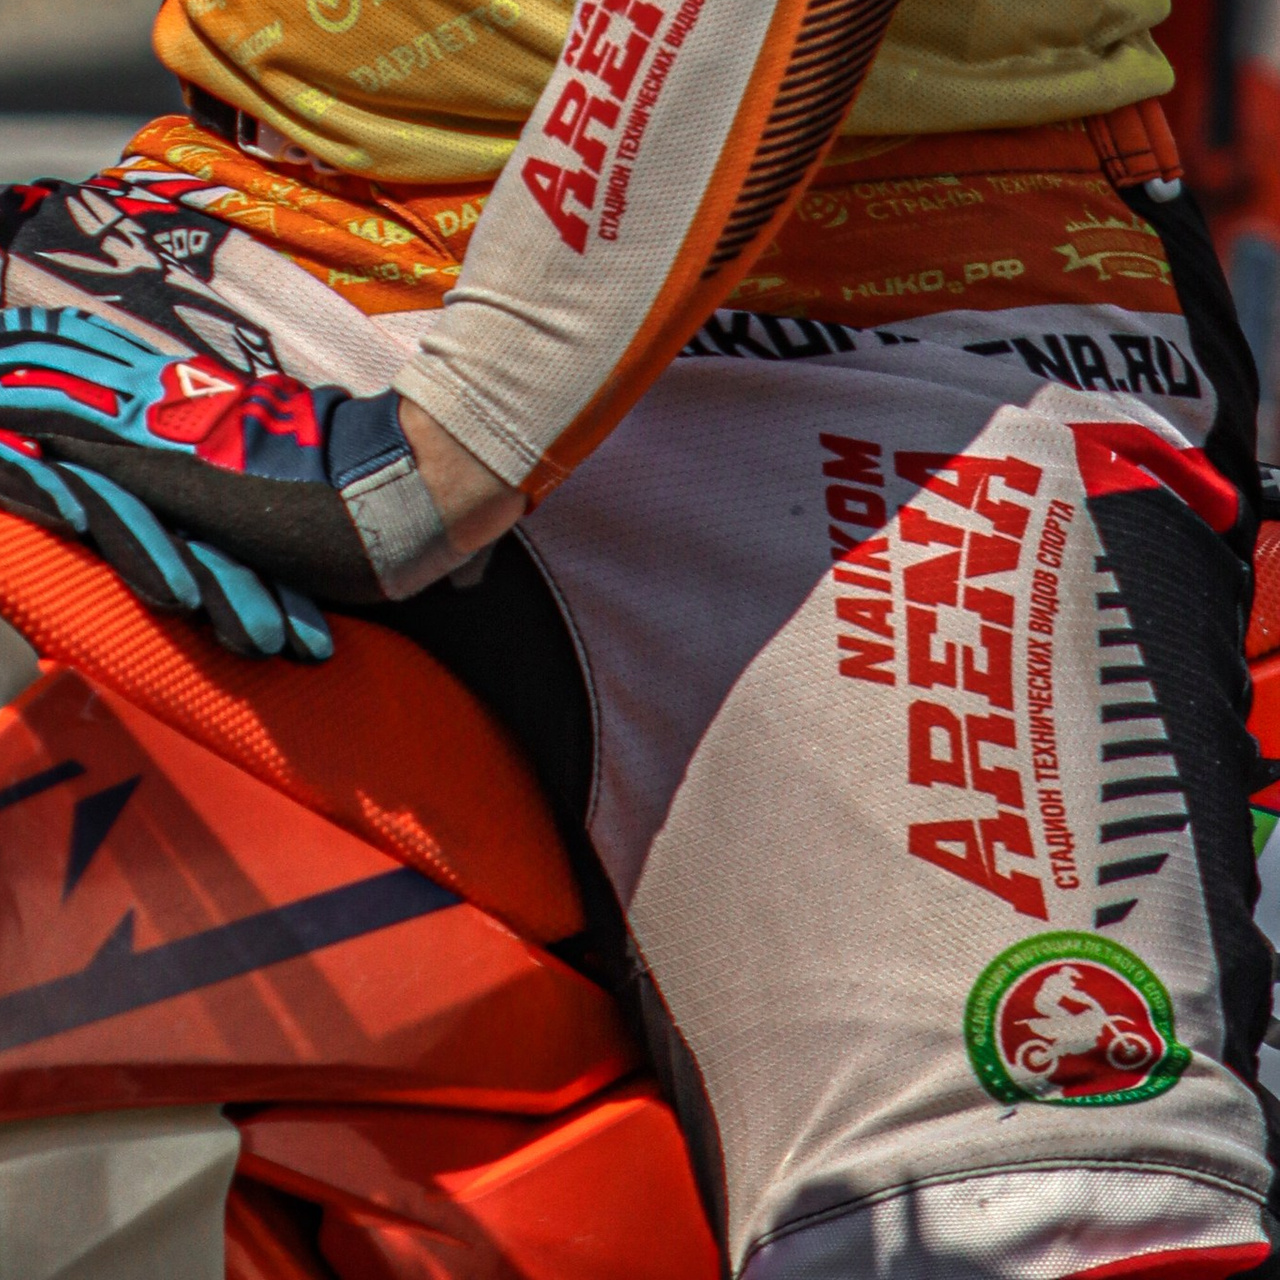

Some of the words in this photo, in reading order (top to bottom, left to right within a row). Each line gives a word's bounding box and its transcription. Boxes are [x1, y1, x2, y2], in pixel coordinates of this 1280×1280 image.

[597, 161, 634, 242] СТАДИОН
[616, 47, 676, 161] ТЕХНИЧЕСКИХ
[819, 432, 897, 690] NAIKOM
[1027, 569, 1060, 636] ВИДОВ
[1036, 498, 1075, 569] СПОРТА
[893, 450, 1050, 922] ARENA
[1026, 637, 1060, 783] ТЕХНИЧЕСКИХ
[1038, 789, 1081, 891] СТАДИОН
